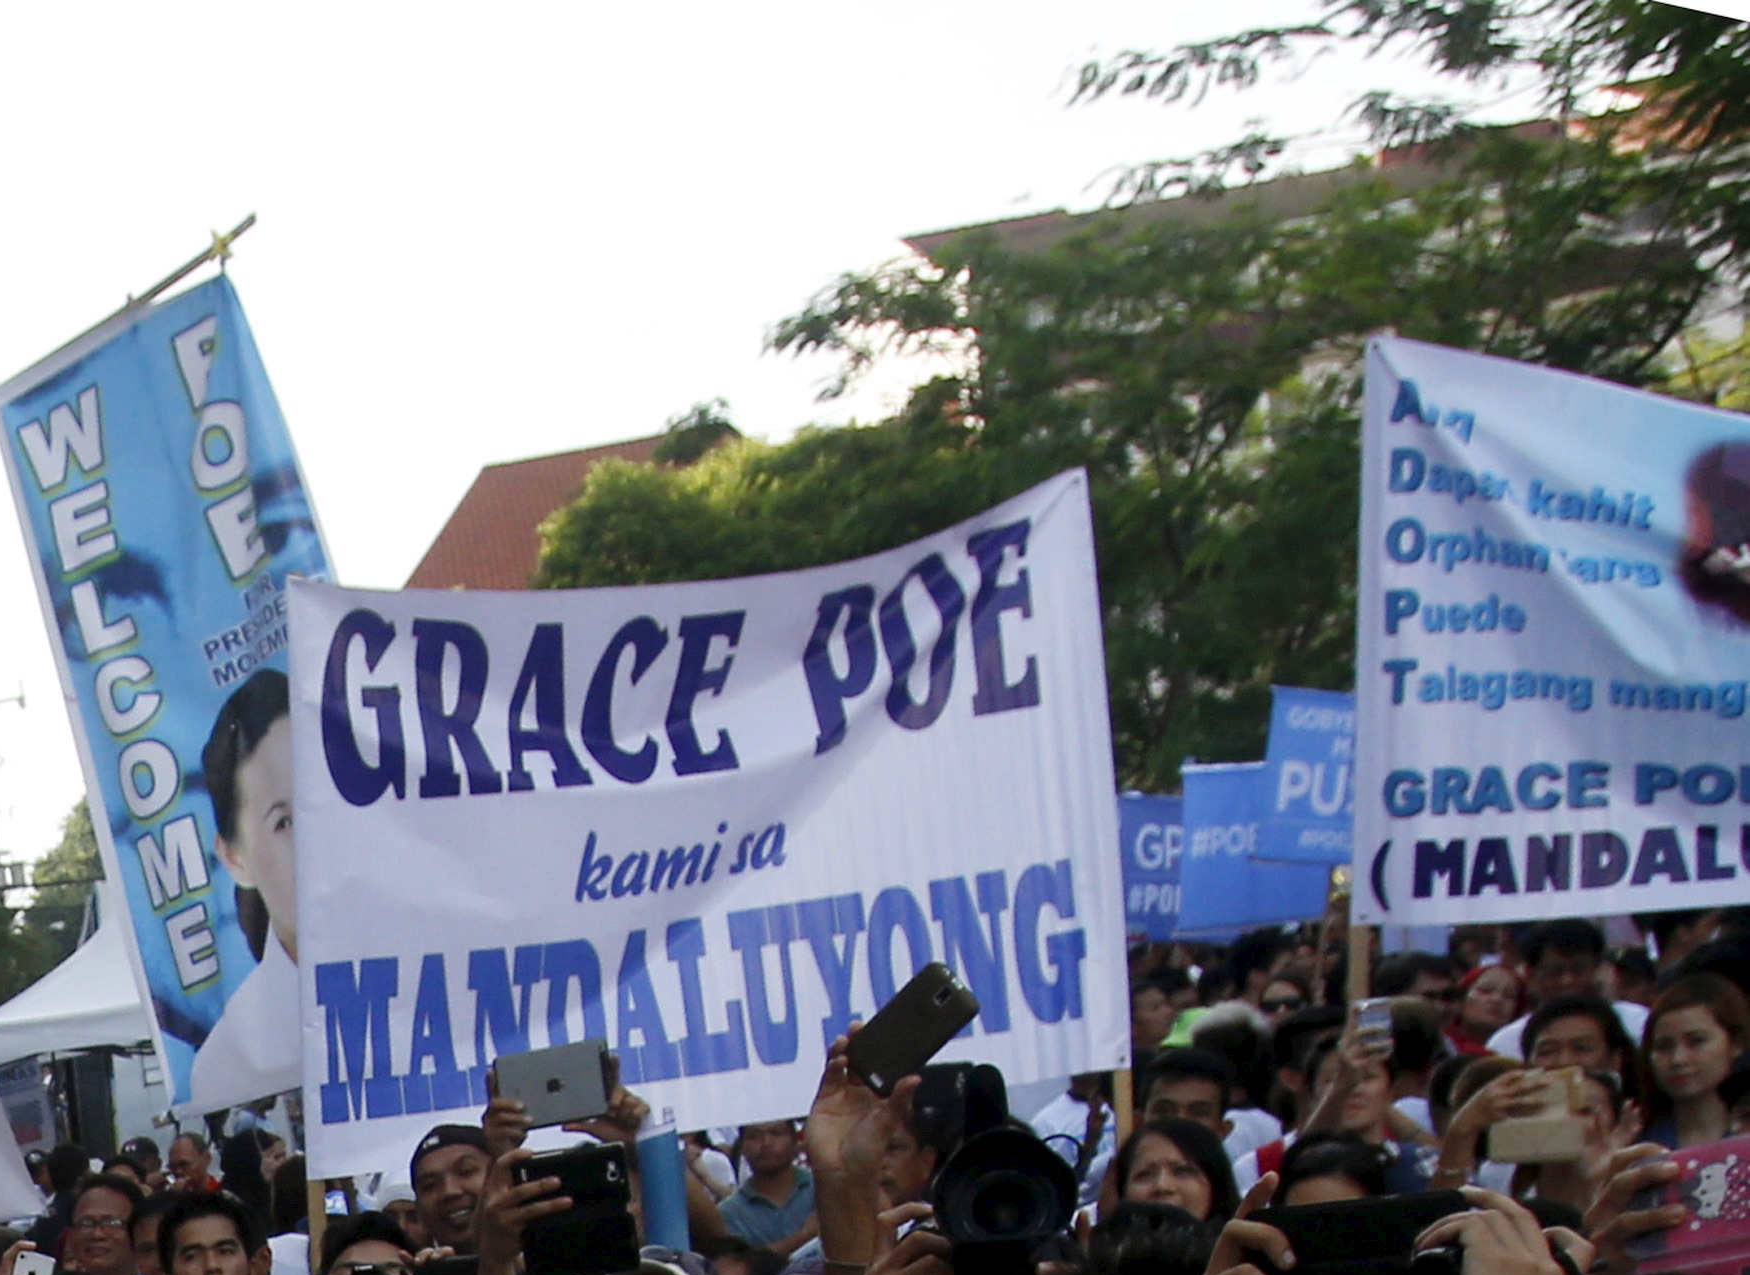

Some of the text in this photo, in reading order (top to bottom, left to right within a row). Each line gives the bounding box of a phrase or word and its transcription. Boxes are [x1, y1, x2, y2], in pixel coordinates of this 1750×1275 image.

[172, 313, 268, 584] POE
[1388, 446, 1655, 531] Dapa kahit
[1385, 516, 1550, 573] Orphan
[1383, 587, 1527, 636] Puede
[18, 381, 221, 996] WELCOME
[321, 516, 1042, 808] GRACE POE
[1382, 659, 1750, 719] Talagang mang
[1276, 758, 1353, 817] PU
[1383, 759, 1611, 818] GRACE
[573, 822, 787, 903] kami sa
